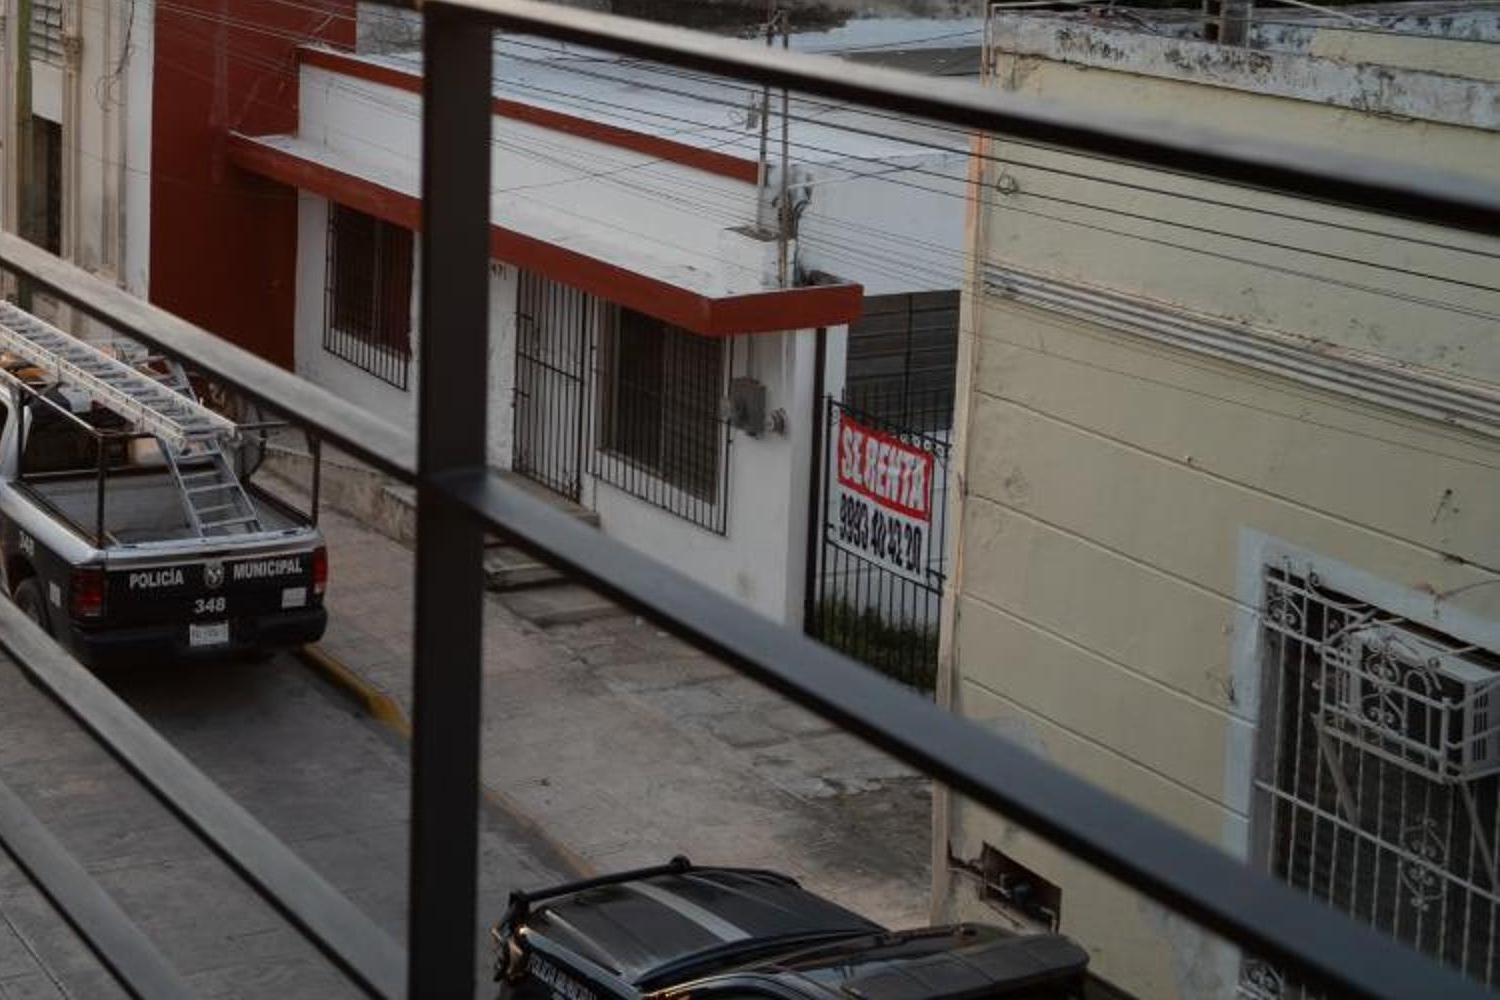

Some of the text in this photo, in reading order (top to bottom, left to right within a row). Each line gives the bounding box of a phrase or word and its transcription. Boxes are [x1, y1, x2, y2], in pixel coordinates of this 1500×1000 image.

[842, 427, 925, 510] SE RENTA
[233, 558, 303, 580] MUNICIPAL
[194, 597, 226, 614] 348
